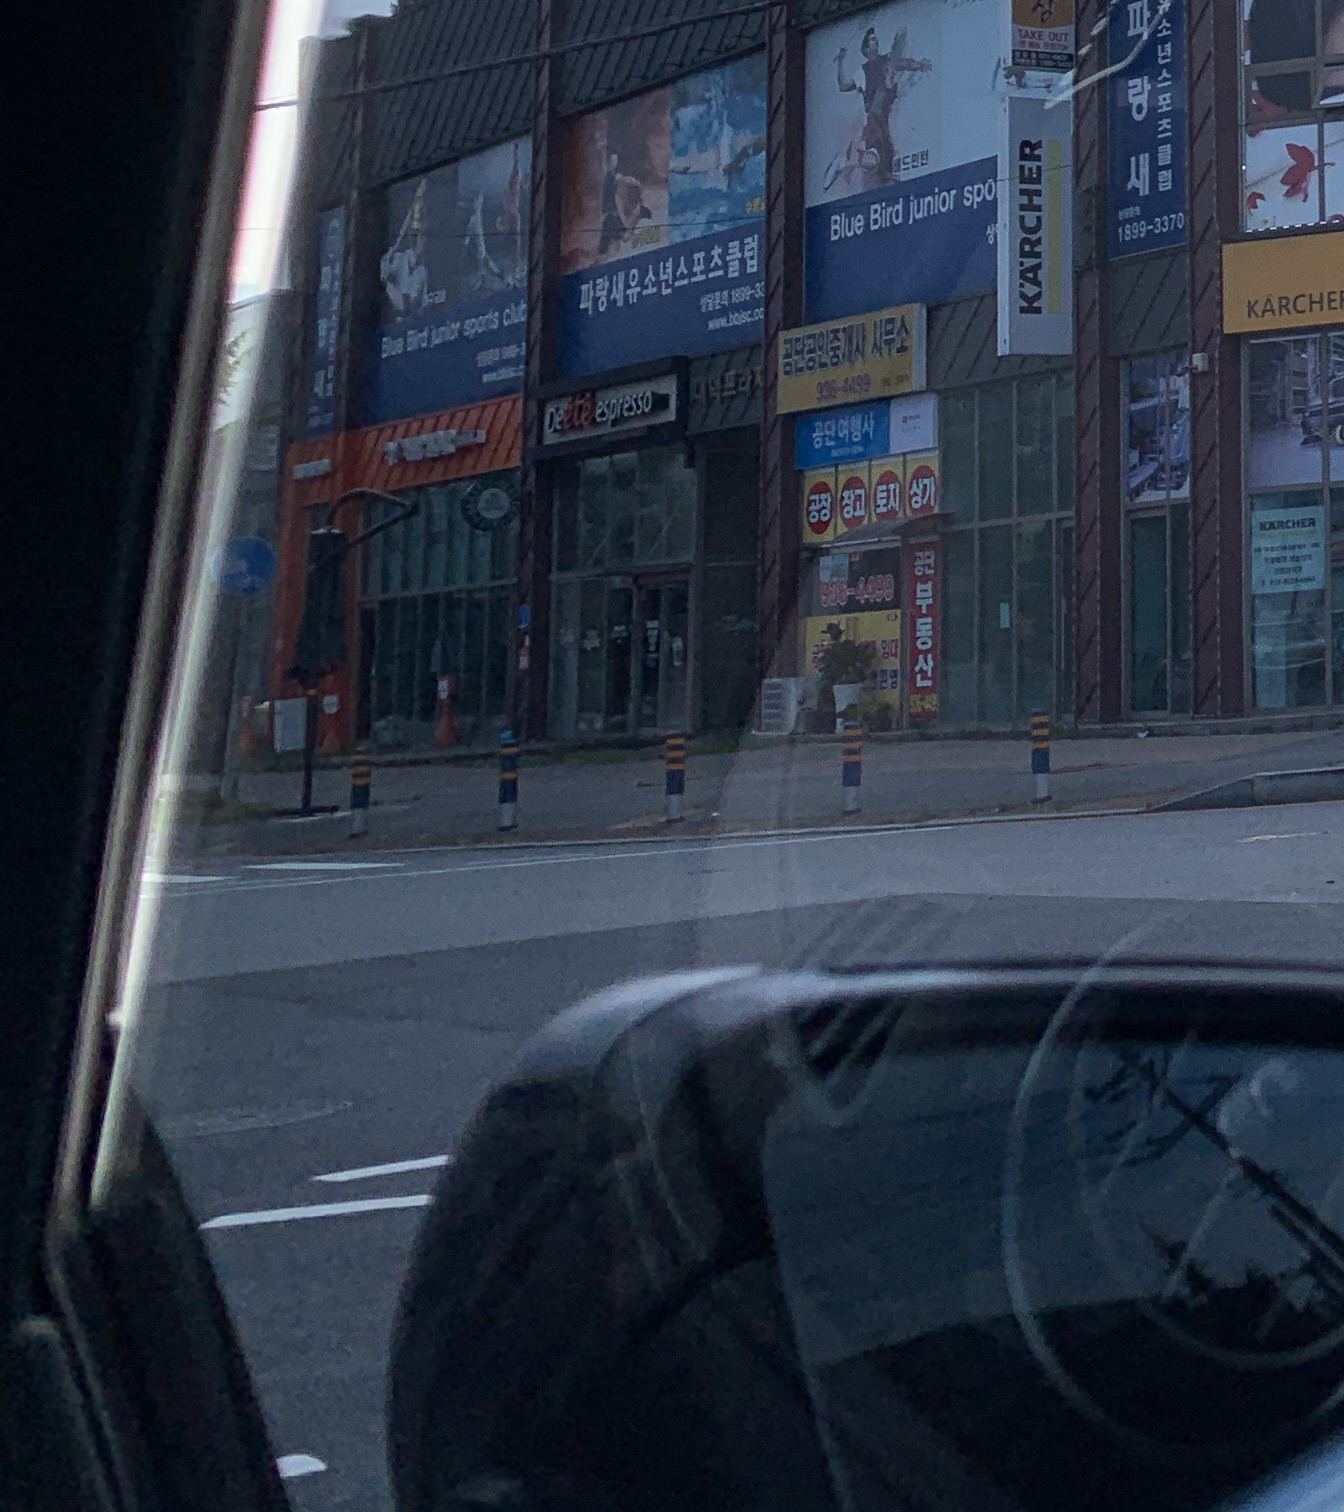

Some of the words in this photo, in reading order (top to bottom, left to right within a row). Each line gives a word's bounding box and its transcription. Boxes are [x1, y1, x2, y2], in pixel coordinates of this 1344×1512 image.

[1018, 29, 1044, 41] TAKE
[1049, 32, 1069, 42] OUT
[830, 213, 864, 241] Blue
[869, 198, 903, 231] Bird
[908, 187, 957, 225] junior
[808, 493, 832, 523] 공장
[842, 488, 867, 518] 창고
[876, 482, 900, 514] 토지
[909, 476, 936, 509] 상가
[914, 581, 934, 687] 부동산
